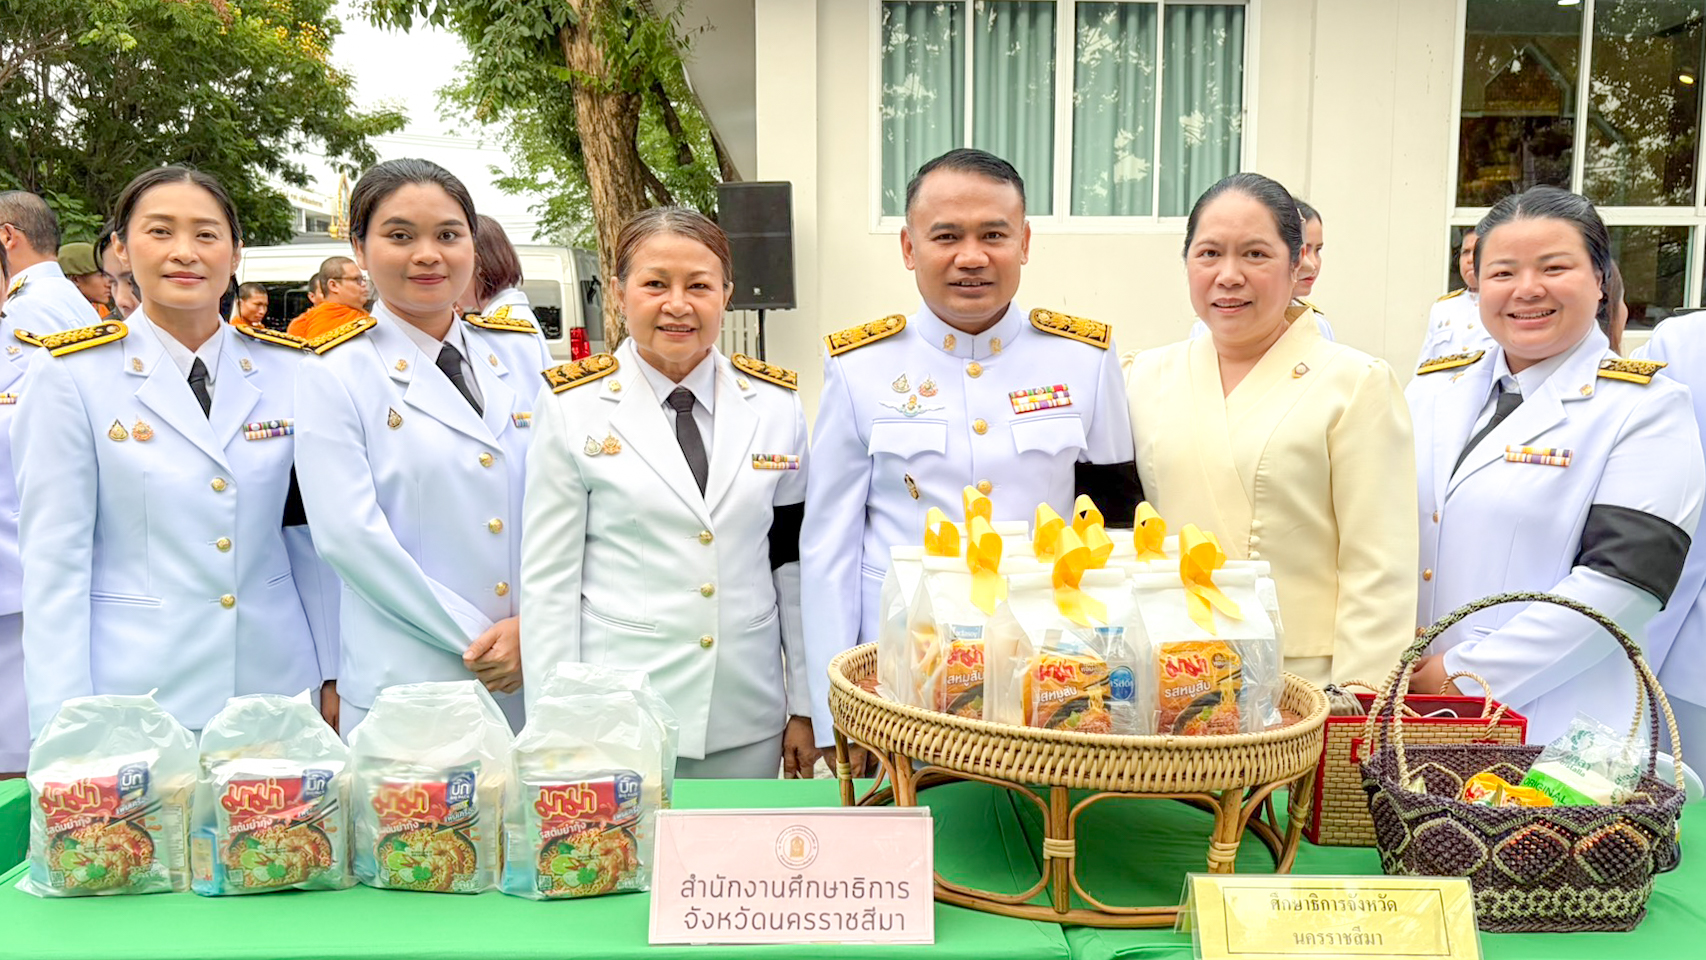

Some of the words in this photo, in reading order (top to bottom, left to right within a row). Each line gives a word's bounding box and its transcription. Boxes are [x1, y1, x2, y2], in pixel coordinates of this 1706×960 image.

[946, 669, 984, 686] สหมูสับ
[1165, 653, 1209, 678] มาม่า
[1164, 680, 1211, 698] รสหมูสับ
[39, 777, 101, 815] มาม่า
[220, 776, 285, 815] มาม่า
[373, 783, 430, 817] มาม่า
[533, 781, 598, 820] มาม่า
[1523, 777, 1568, 805] ORIGINAL
[46, 815, 92, 835] รสต้มยำกุ้ง
[227, 817, 273, 834] รสต้มยำกุ้ง
[539, 821, 587, 839] รสต้มยำกุ้ง
[680, 873, 910, 899] สำนักงานศึกษาธิการ
[1270, 893, 1398, 912] ศึกษาธิการจังหวัด
[683, 906, 905, 931] จังหวัดนครราชสีมา
[1293, 926, 1383, 946] นครราชสีมา
